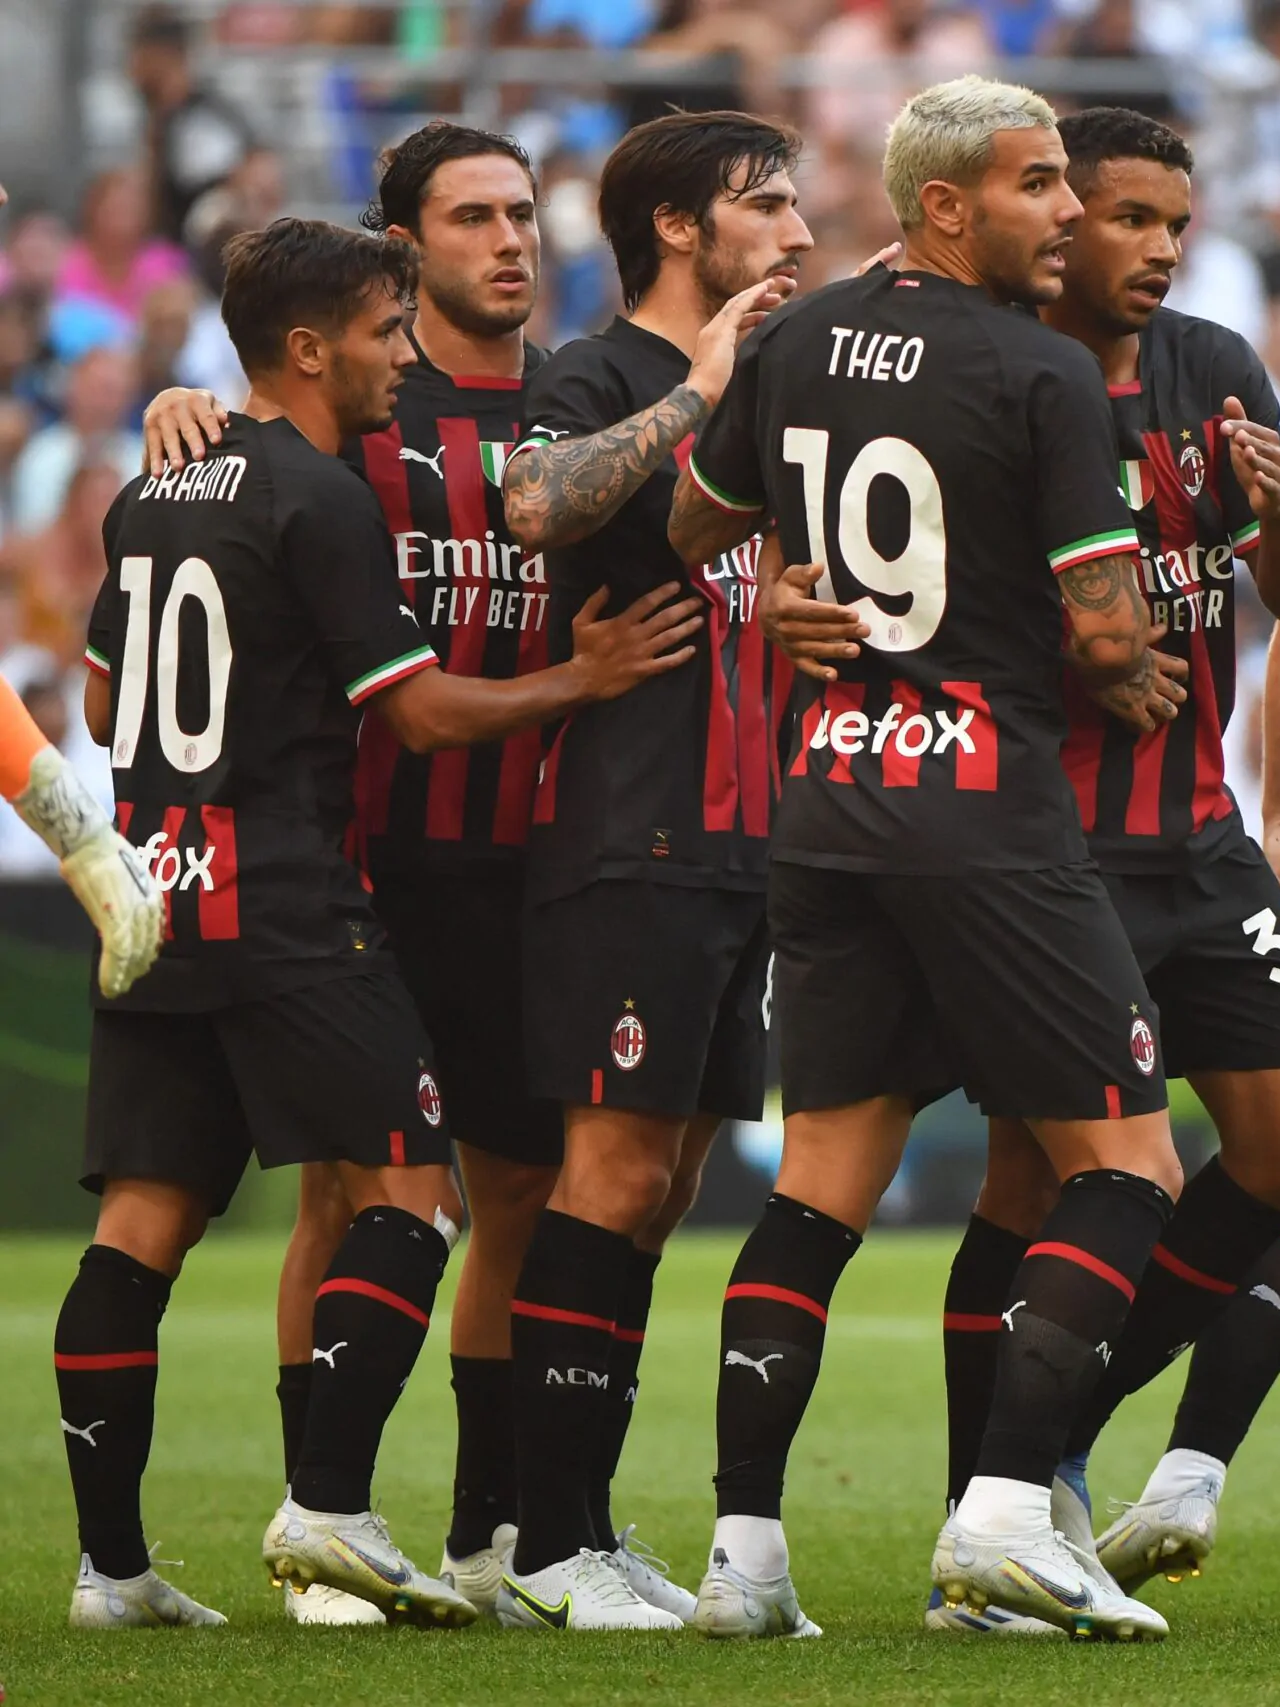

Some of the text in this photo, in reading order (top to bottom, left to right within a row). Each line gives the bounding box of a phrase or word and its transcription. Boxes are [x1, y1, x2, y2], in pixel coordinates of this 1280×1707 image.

[828, 326, 924, 383] THEO
[783, 427, 946, 652] 19
[430, 586, 550, 631] FLY BETT
[728, 584, 758, 623] FLY
[111, 556, 233, 774] 10
[545, 1367, 610, 1390] ACM
